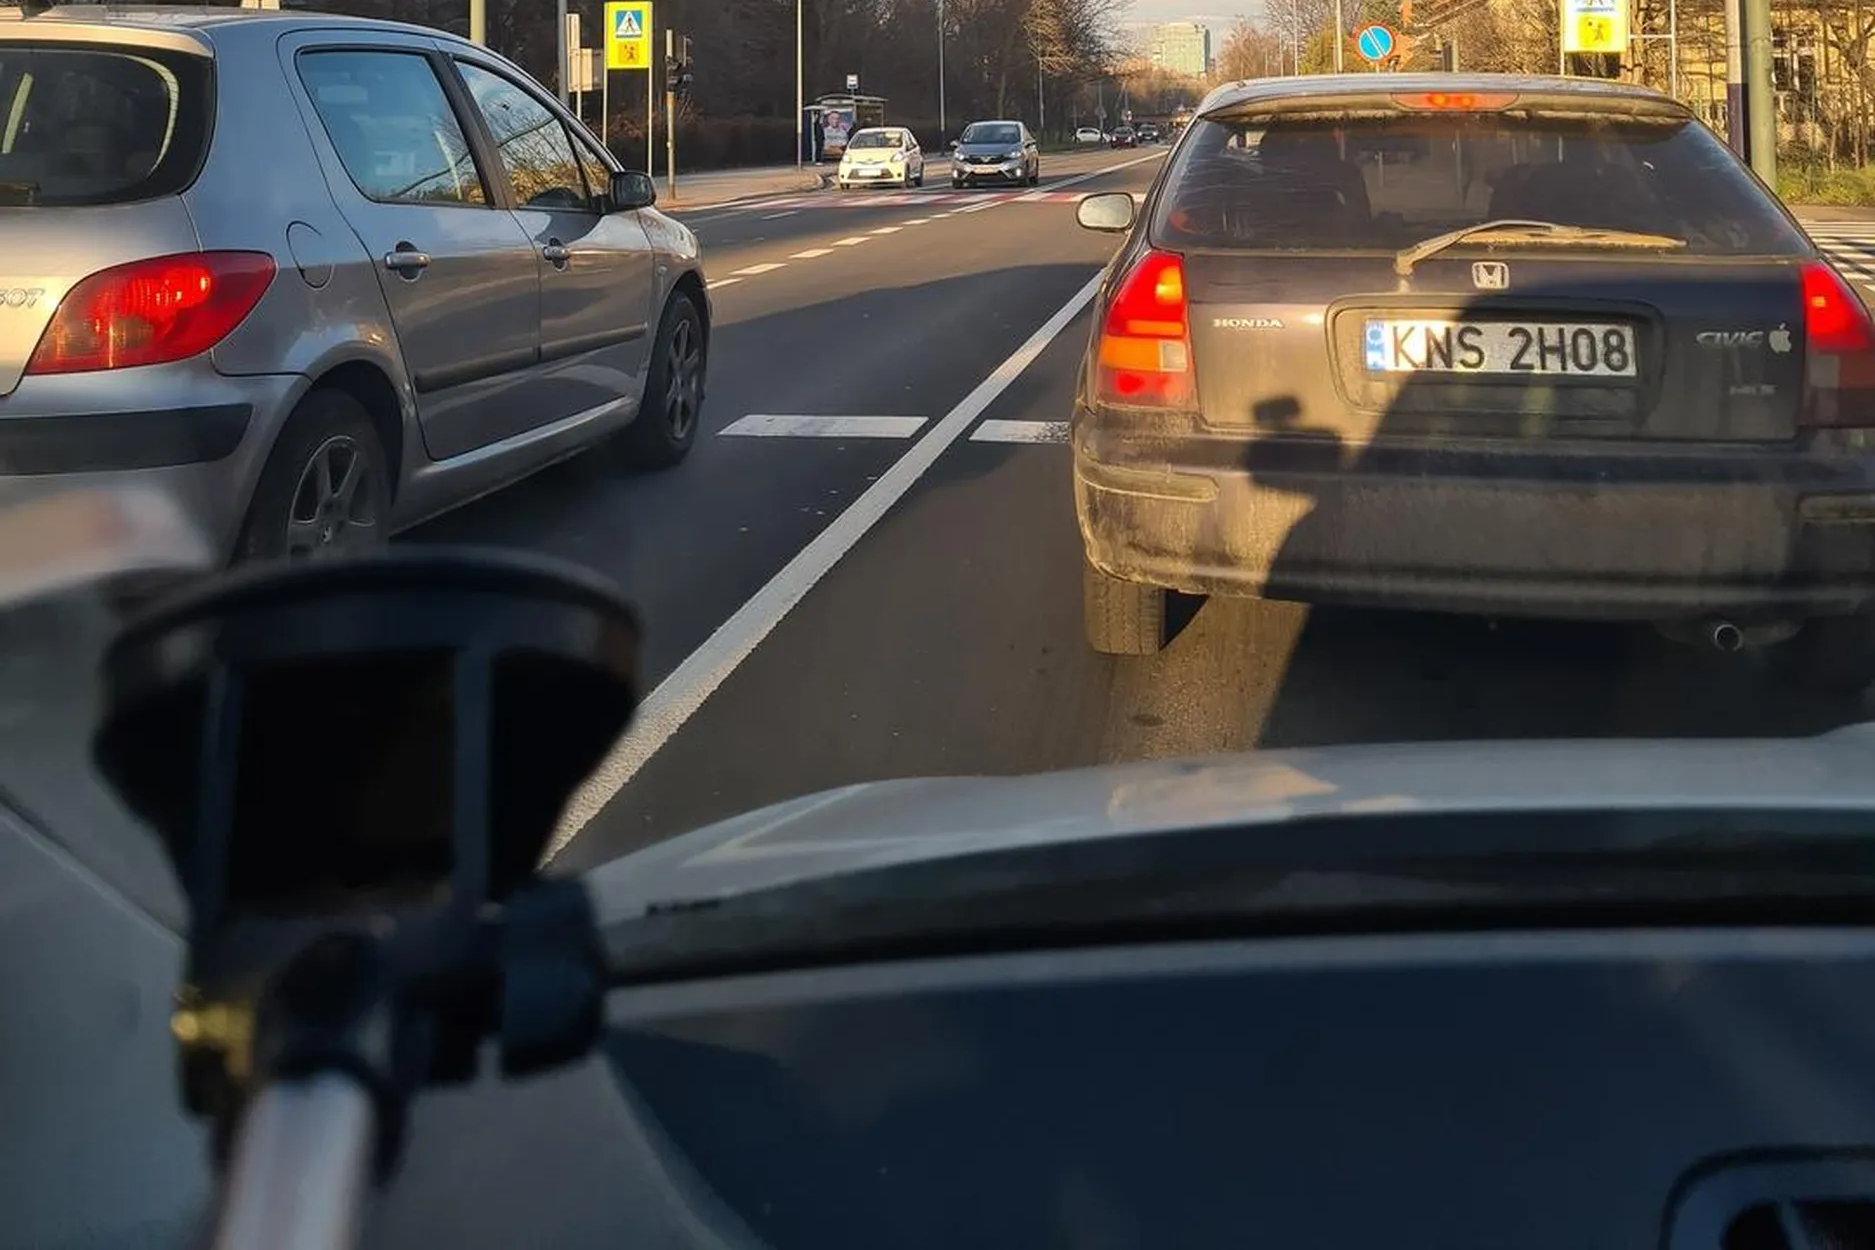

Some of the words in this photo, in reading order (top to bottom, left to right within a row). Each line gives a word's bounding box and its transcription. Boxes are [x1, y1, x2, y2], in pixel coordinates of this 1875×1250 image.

[1213, 318, 1284, 328] HONDA
[1696, 331, 1765, 348] CIVIC
[1393, 326, 1485, 370] KNS
[1508, 327, 1629, 372] 2H08
